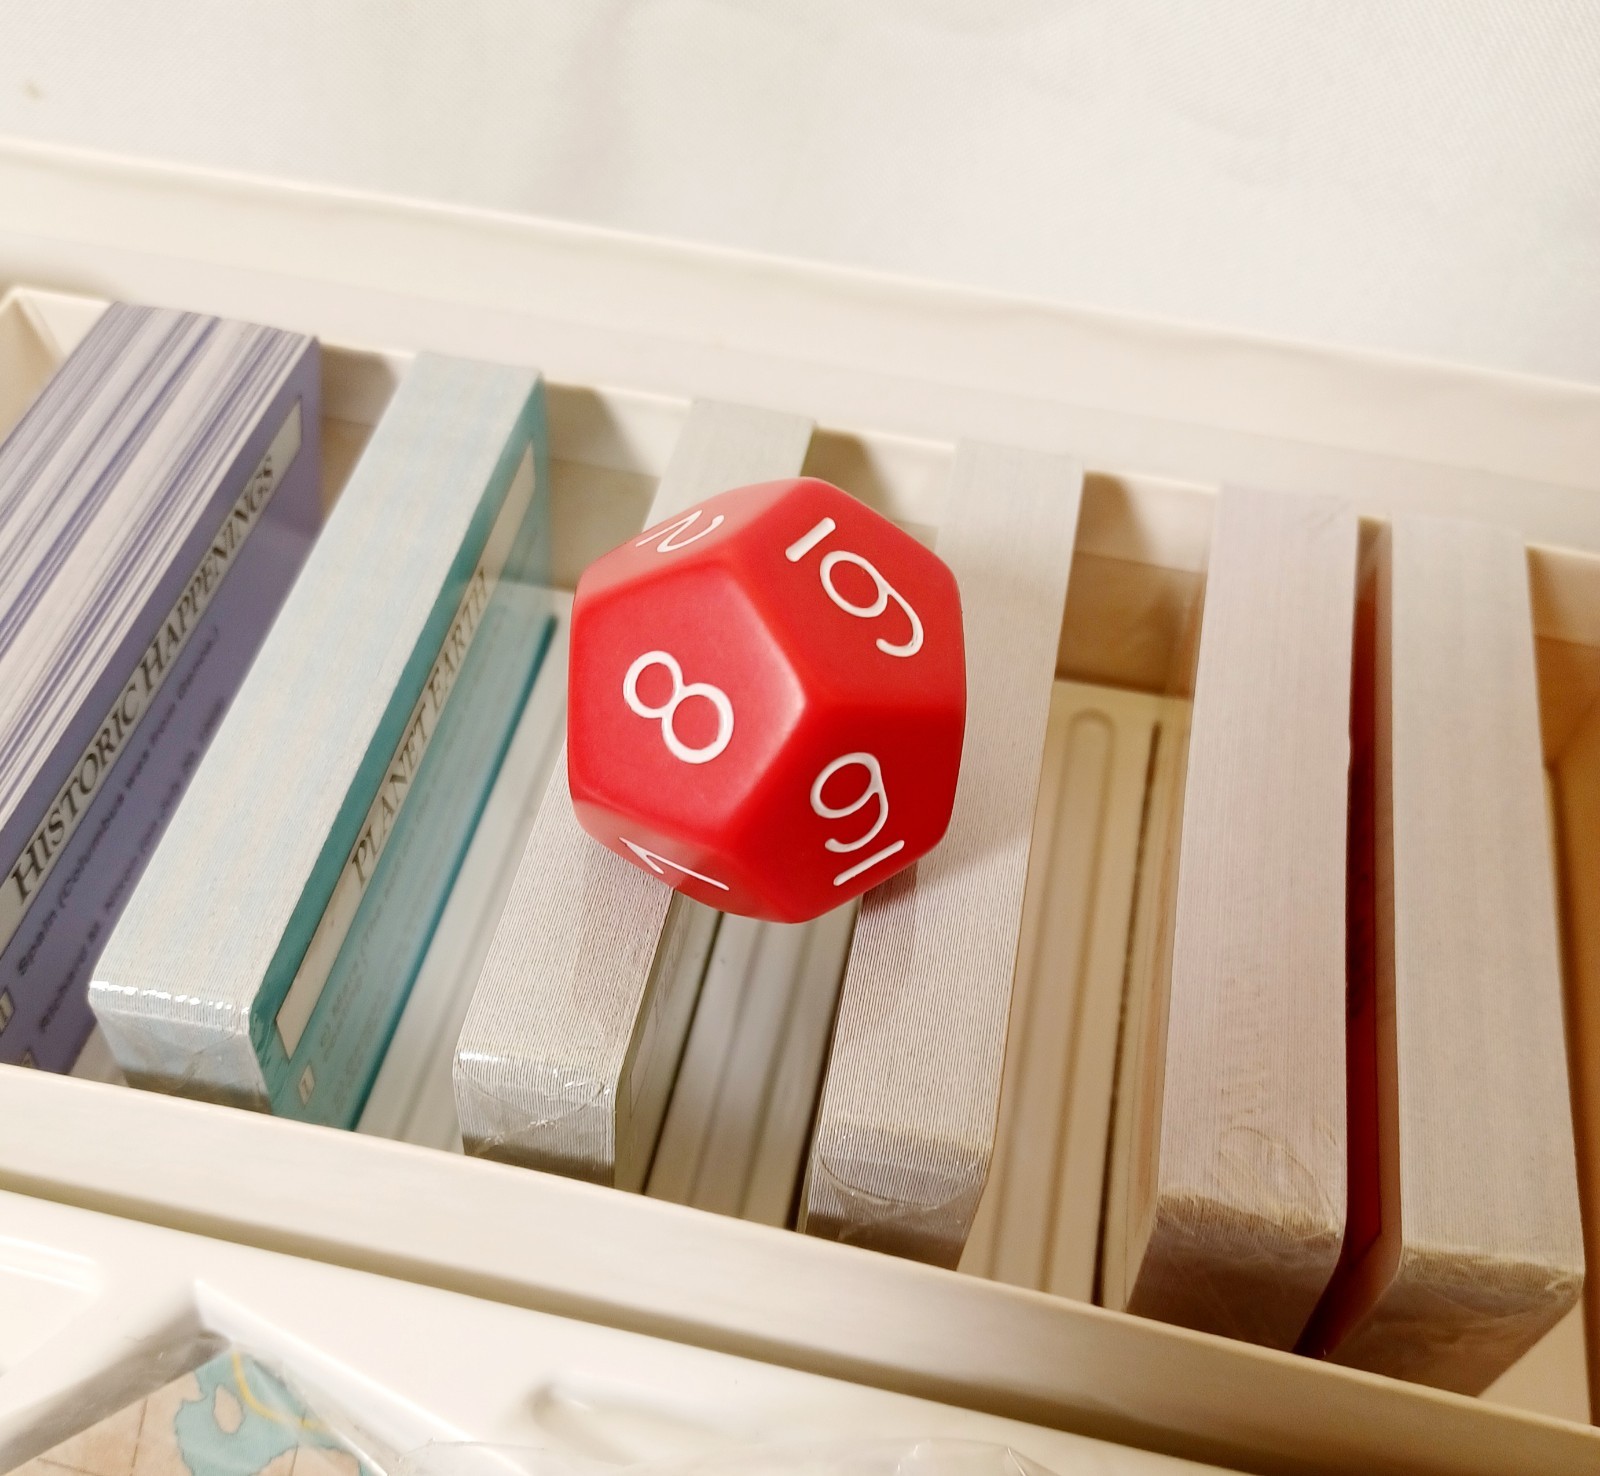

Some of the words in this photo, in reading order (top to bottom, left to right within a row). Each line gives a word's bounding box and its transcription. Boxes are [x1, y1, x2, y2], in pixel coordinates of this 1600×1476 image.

[635, 510, 725, 553] 2
[11, 682, 139, 902] HISTORIC
[138, 454, 275, 692] HAPPENINGS
[352, 703, 429, 884] PLANET
[426, 567, 488, 716] EARTH
[622, 650, 734, 764] 8
